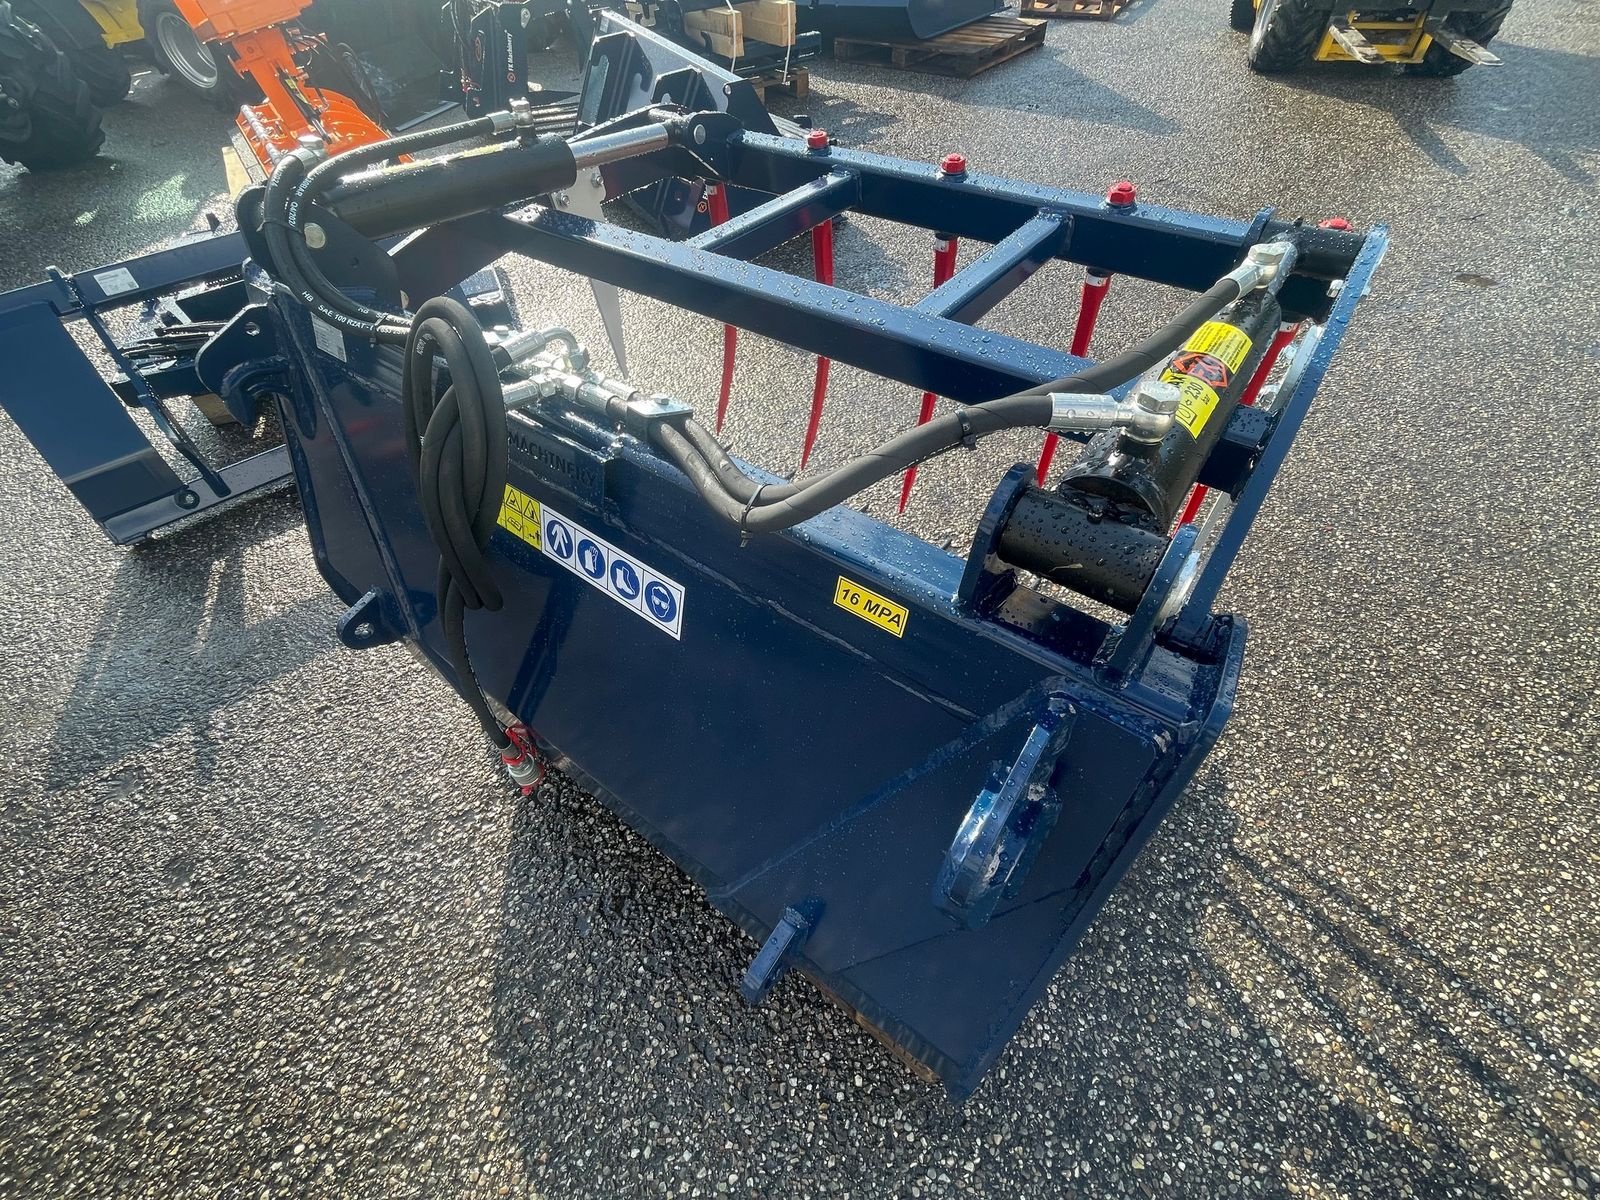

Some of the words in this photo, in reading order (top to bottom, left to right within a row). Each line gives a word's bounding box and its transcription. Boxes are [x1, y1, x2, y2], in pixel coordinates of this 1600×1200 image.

[301, 290, 314, 302] HB
[317, 304, 333, 317] SAE
[334, 313, 347, 323] 100
[1184, 381, 1204, 400] 230
[508, 430, 597, 487] MACHINERY
[842, 588, 861, 606] 16
[863, 599, 902, 628] MPA
